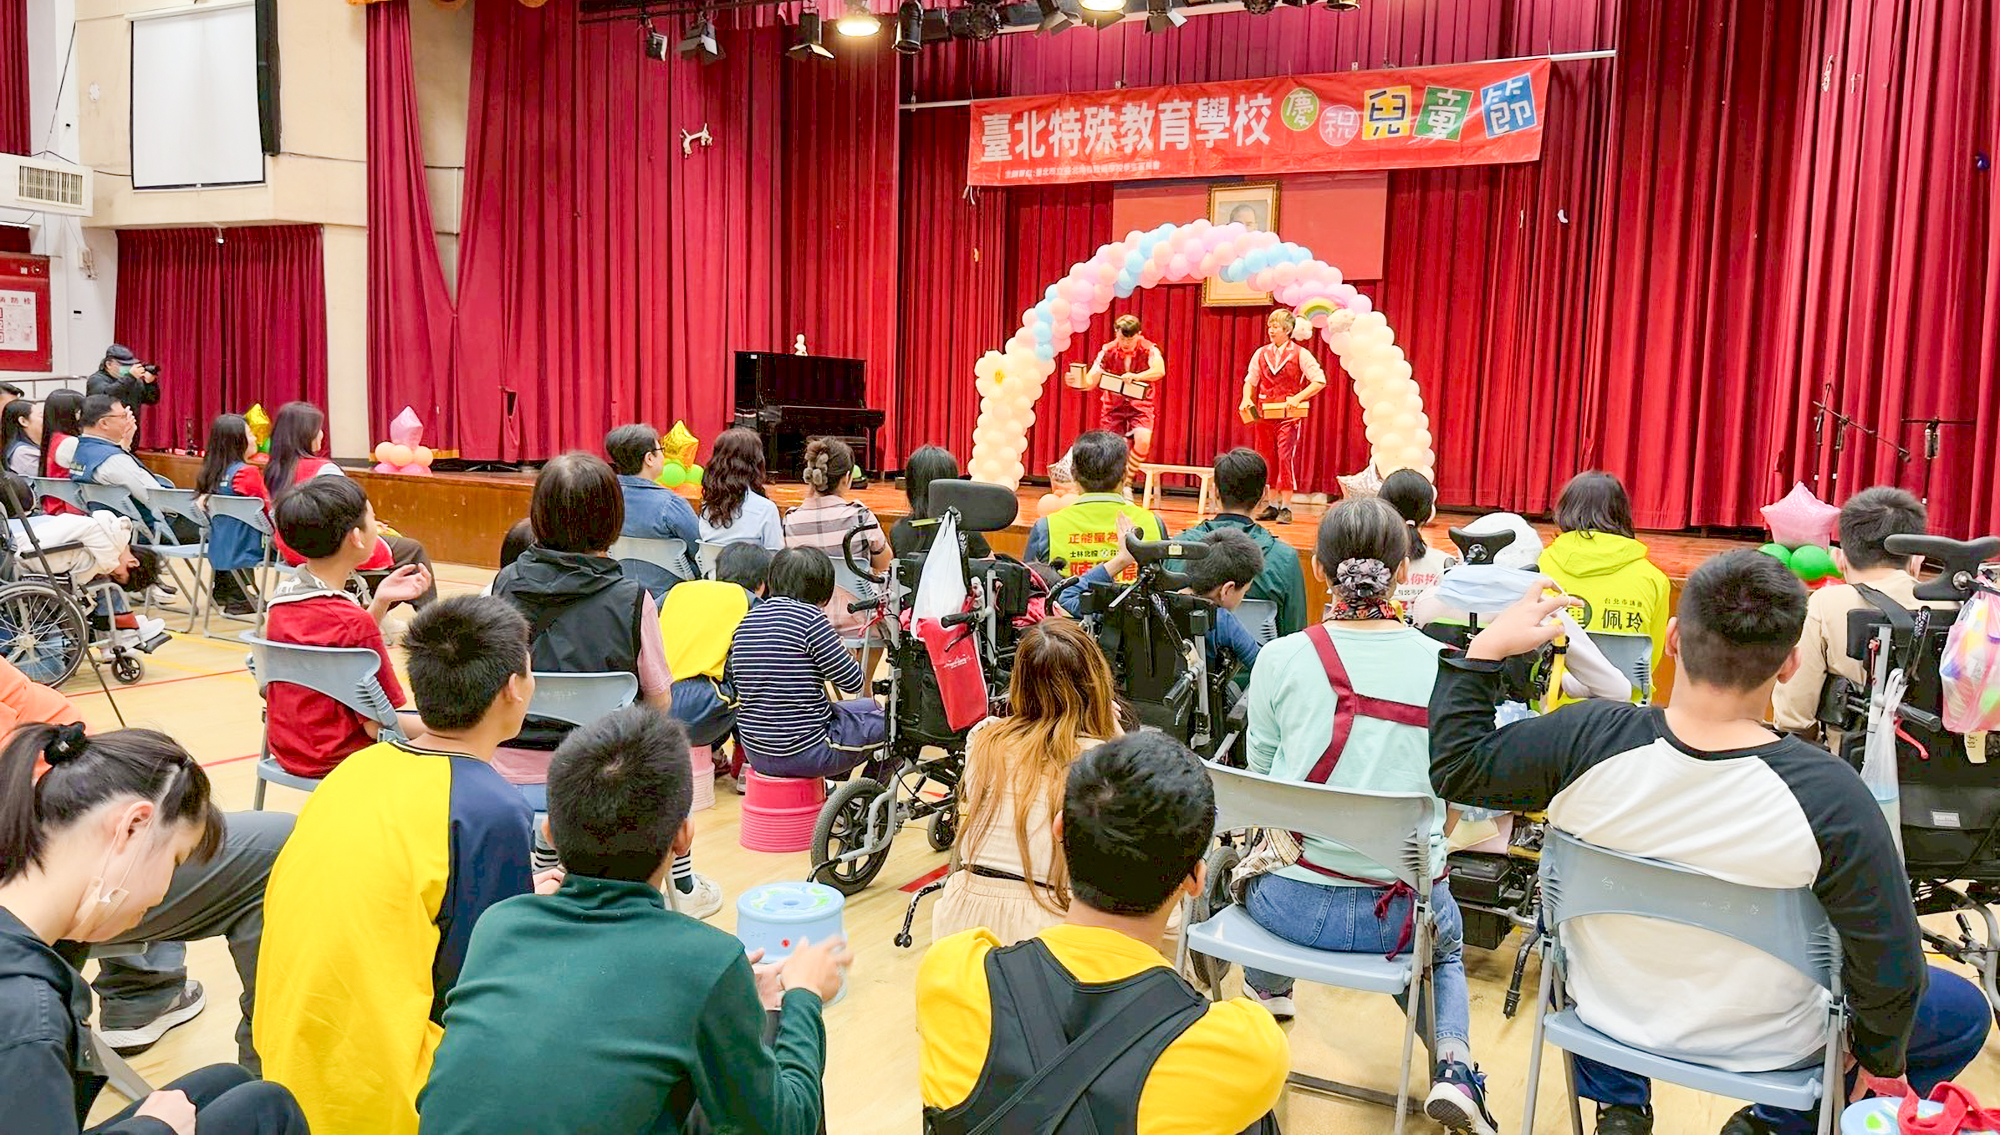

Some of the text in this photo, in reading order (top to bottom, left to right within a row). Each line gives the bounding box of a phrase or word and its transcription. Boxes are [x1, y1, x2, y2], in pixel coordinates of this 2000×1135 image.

[981, 92, 1272, 162] 臺北特殊教育學校
[1287, 80, 1531, 138] 慶祝兒童節
[1601, 607, 1643, 633] 佩玲
